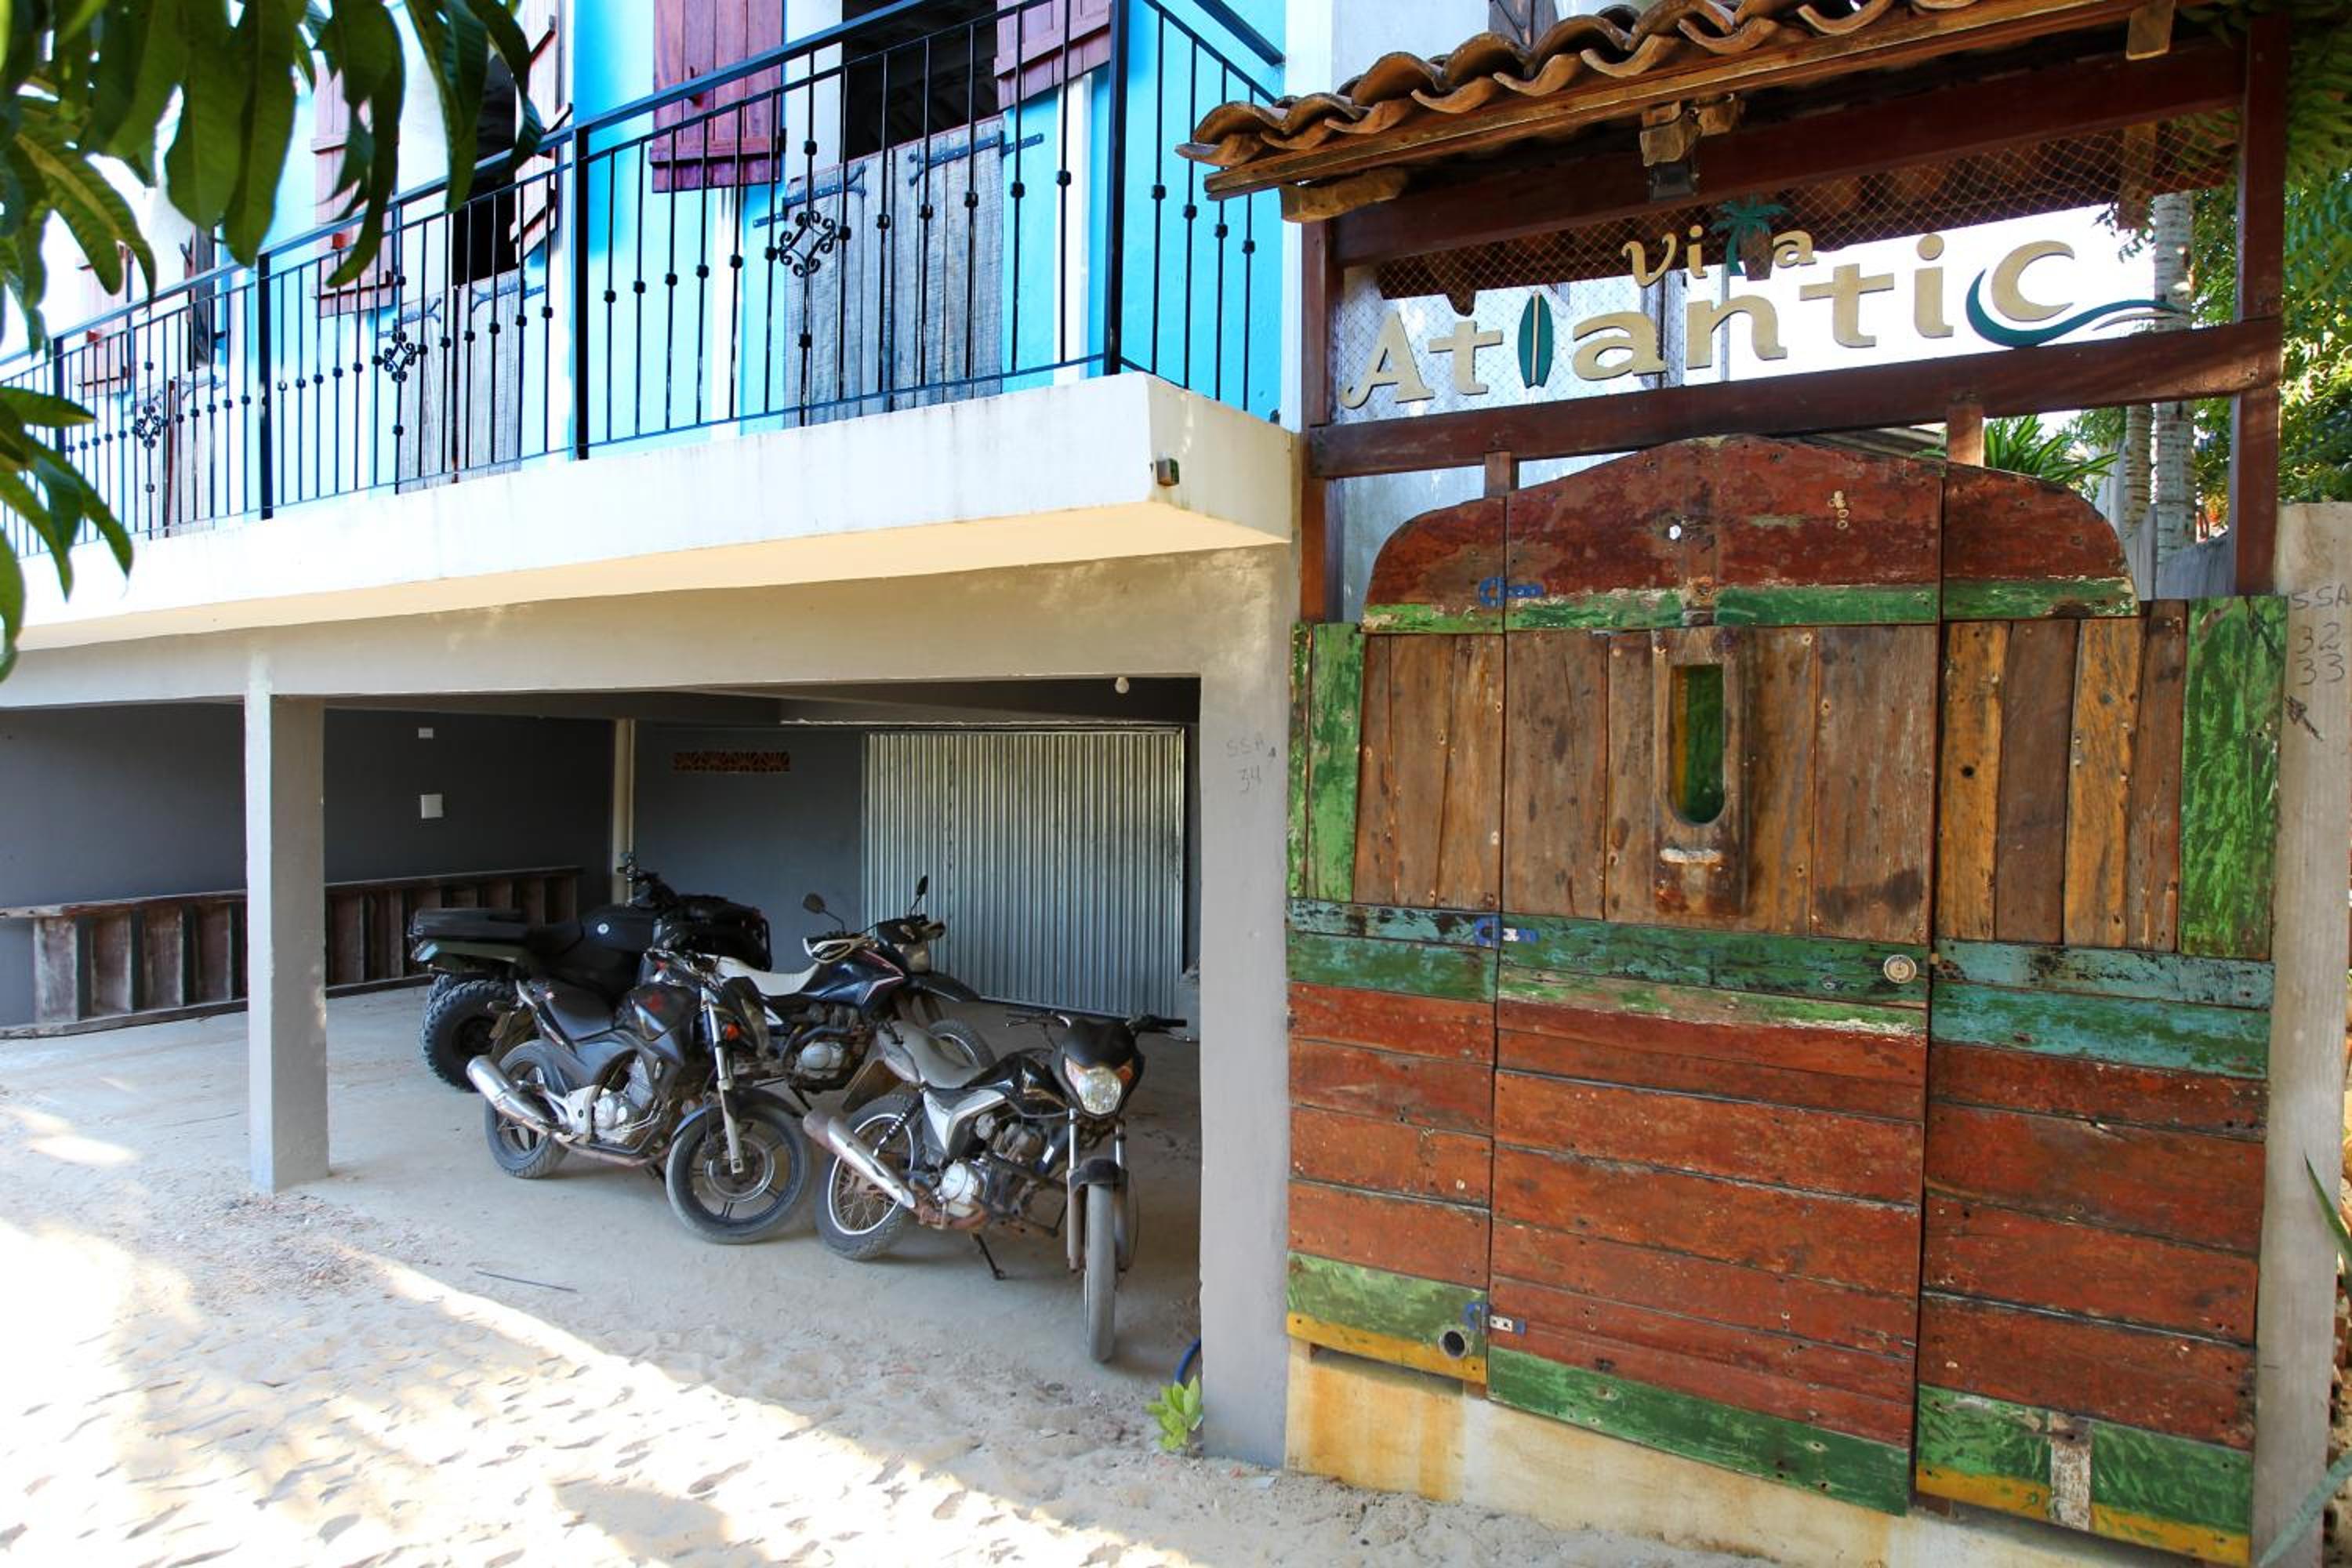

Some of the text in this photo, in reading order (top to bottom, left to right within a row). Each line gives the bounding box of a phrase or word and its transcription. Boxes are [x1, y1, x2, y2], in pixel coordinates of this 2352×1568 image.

[2291, 583, 2351, 610] SSA
[2296, 622, 2341, 654] 32
[2296, 654, 2345, 685] 33
